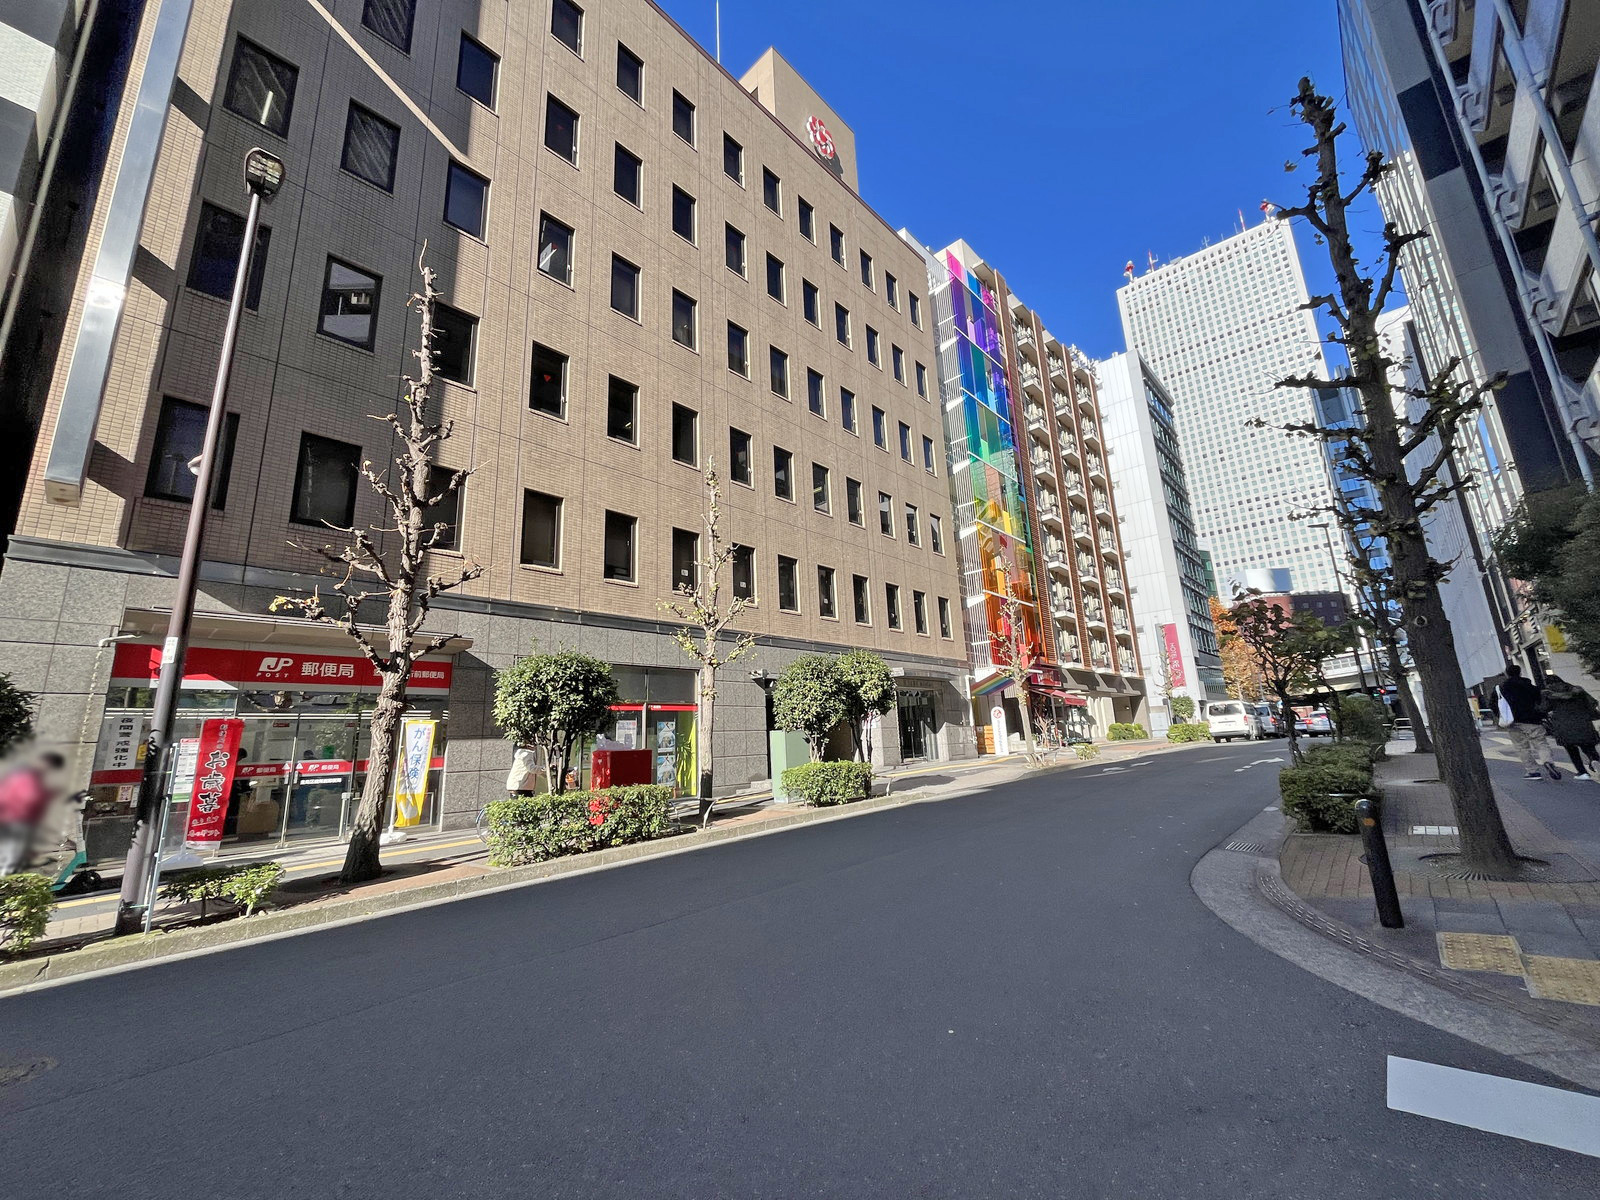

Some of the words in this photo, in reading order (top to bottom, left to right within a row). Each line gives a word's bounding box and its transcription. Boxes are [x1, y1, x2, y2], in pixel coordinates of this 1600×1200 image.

[1169, 642, 1177, 660] HOTEL
[301, 661, 355, 678] 郵便局
[197, 749, 231, 814] お歳暮
